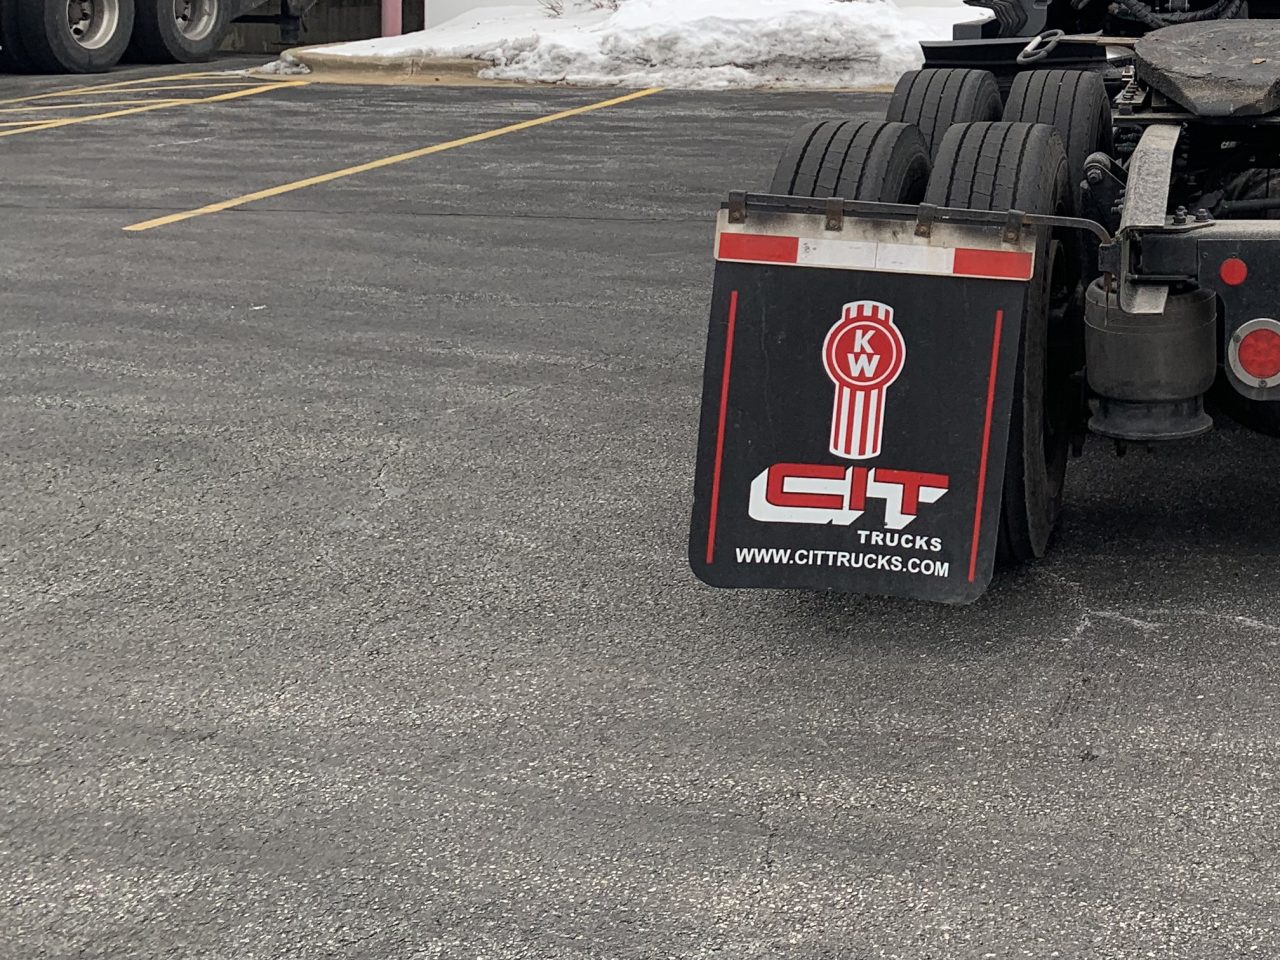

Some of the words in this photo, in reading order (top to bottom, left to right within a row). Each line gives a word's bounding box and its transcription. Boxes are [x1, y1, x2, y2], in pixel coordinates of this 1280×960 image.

[749, 462, 949, 530] CIT
[857, 529, 943, 552] TRUCKS
[735, 547, 950, 578] WWW.CITTRUCKS.COM
